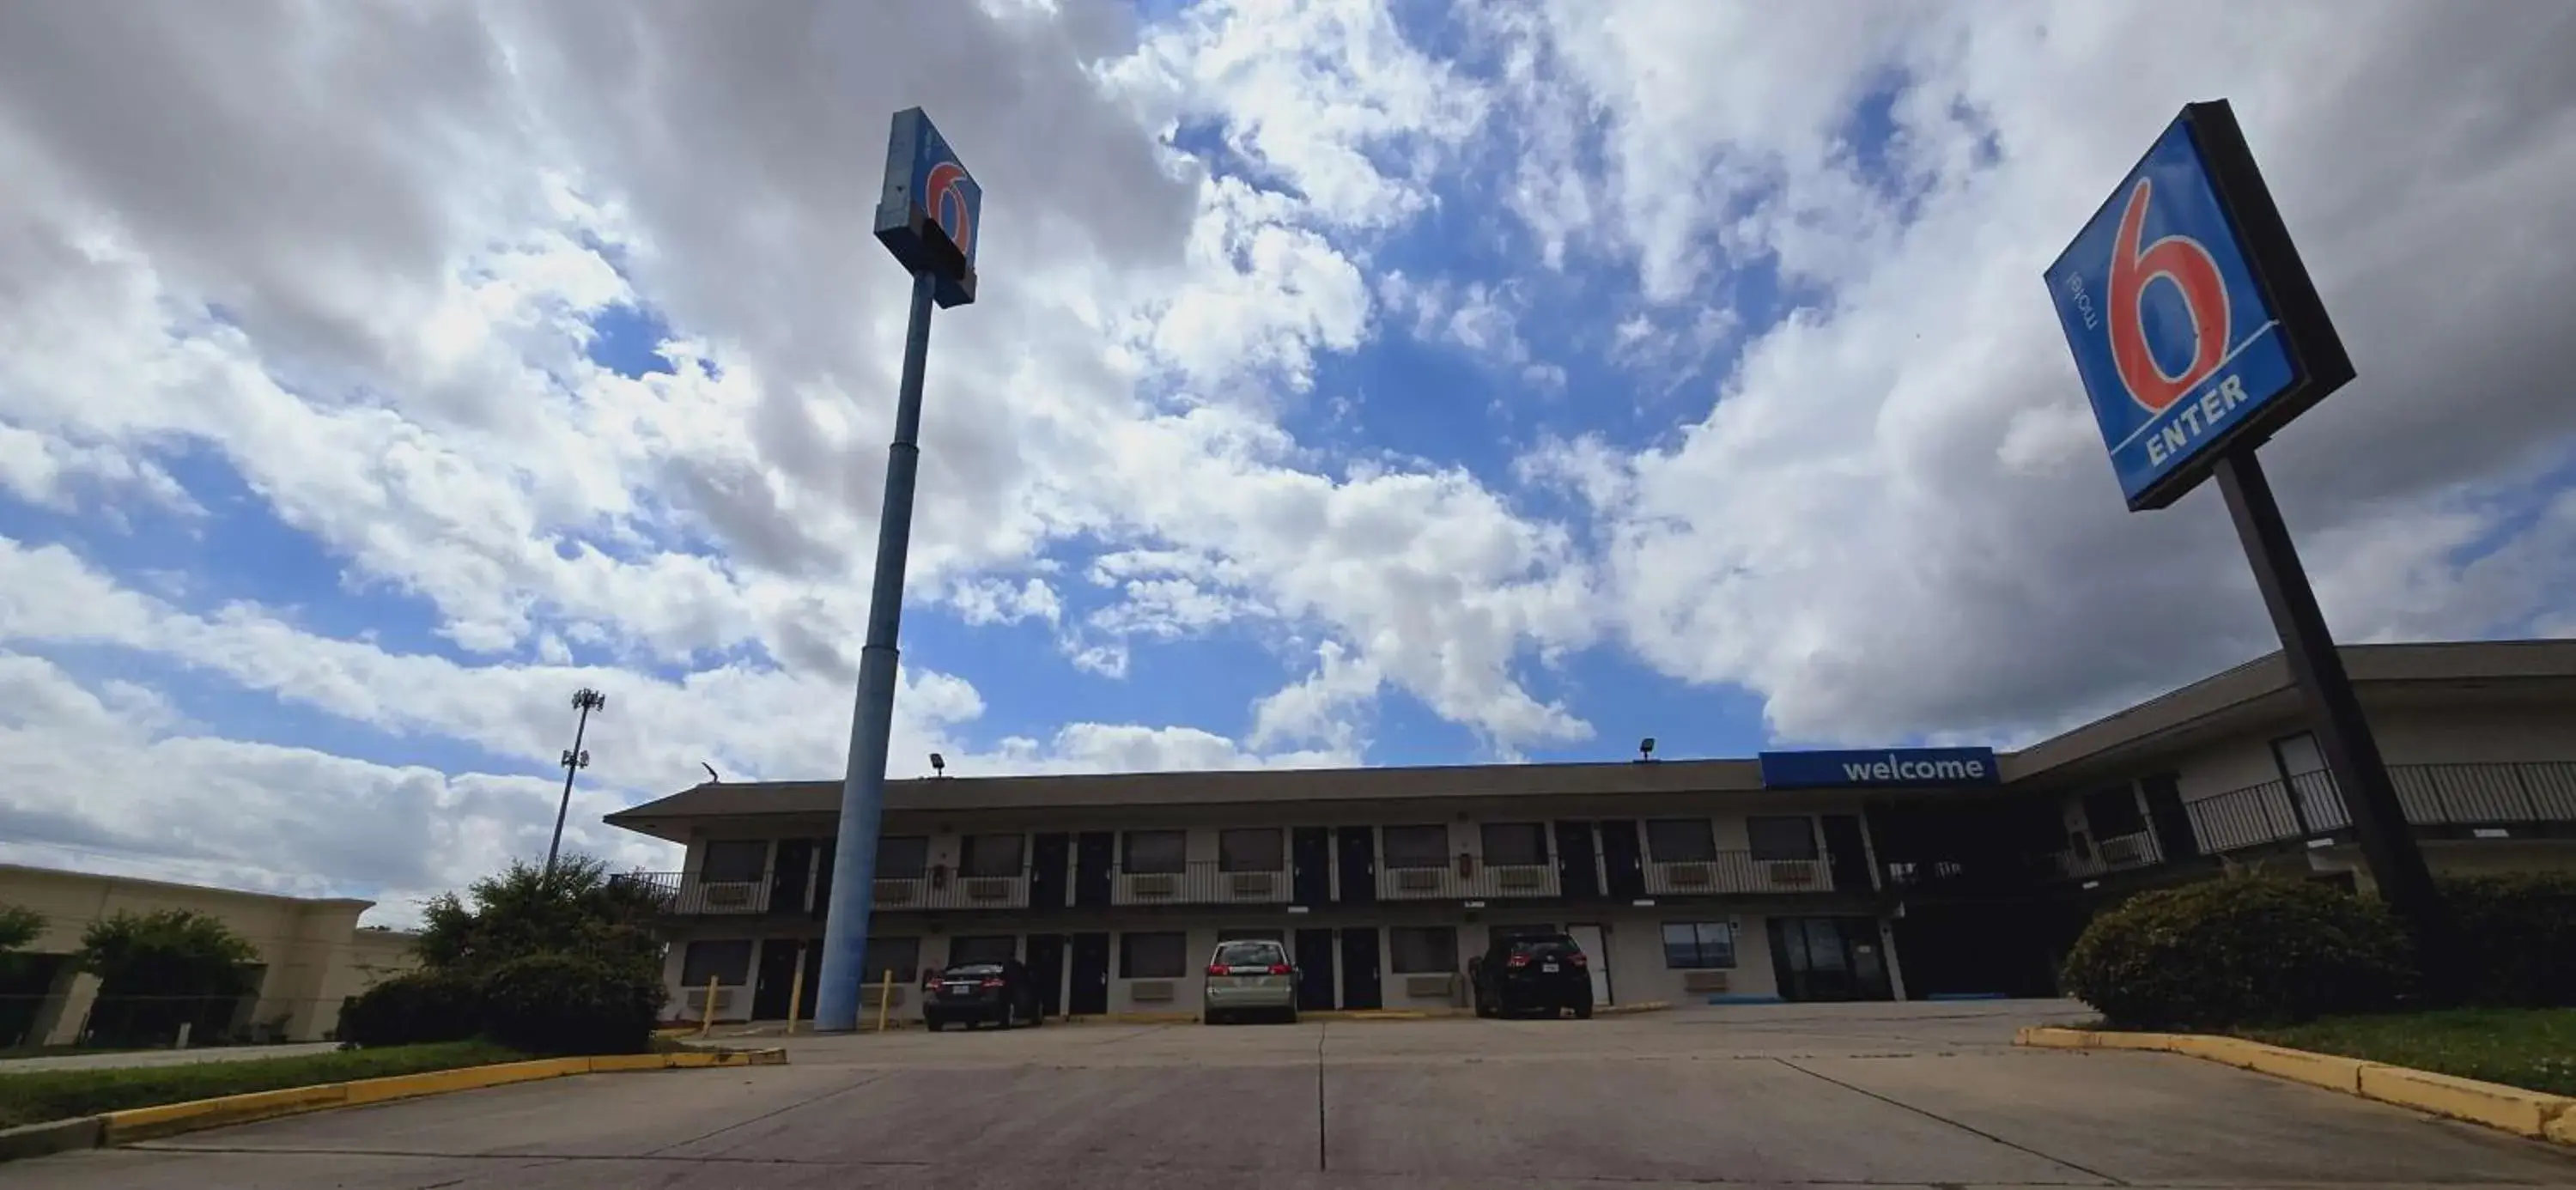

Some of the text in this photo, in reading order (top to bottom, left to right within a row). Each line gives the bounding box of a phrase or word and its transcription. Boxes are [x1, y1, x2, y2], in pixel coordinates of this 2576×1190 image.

[926, 161, 971, 256] 6
[2066, 270, 2099, 331] motel
[2107, 176, 2231, 416] 6
[2145, 373, 2249, 467] ENTER
[1843, 752, 1984, 782] welcome
